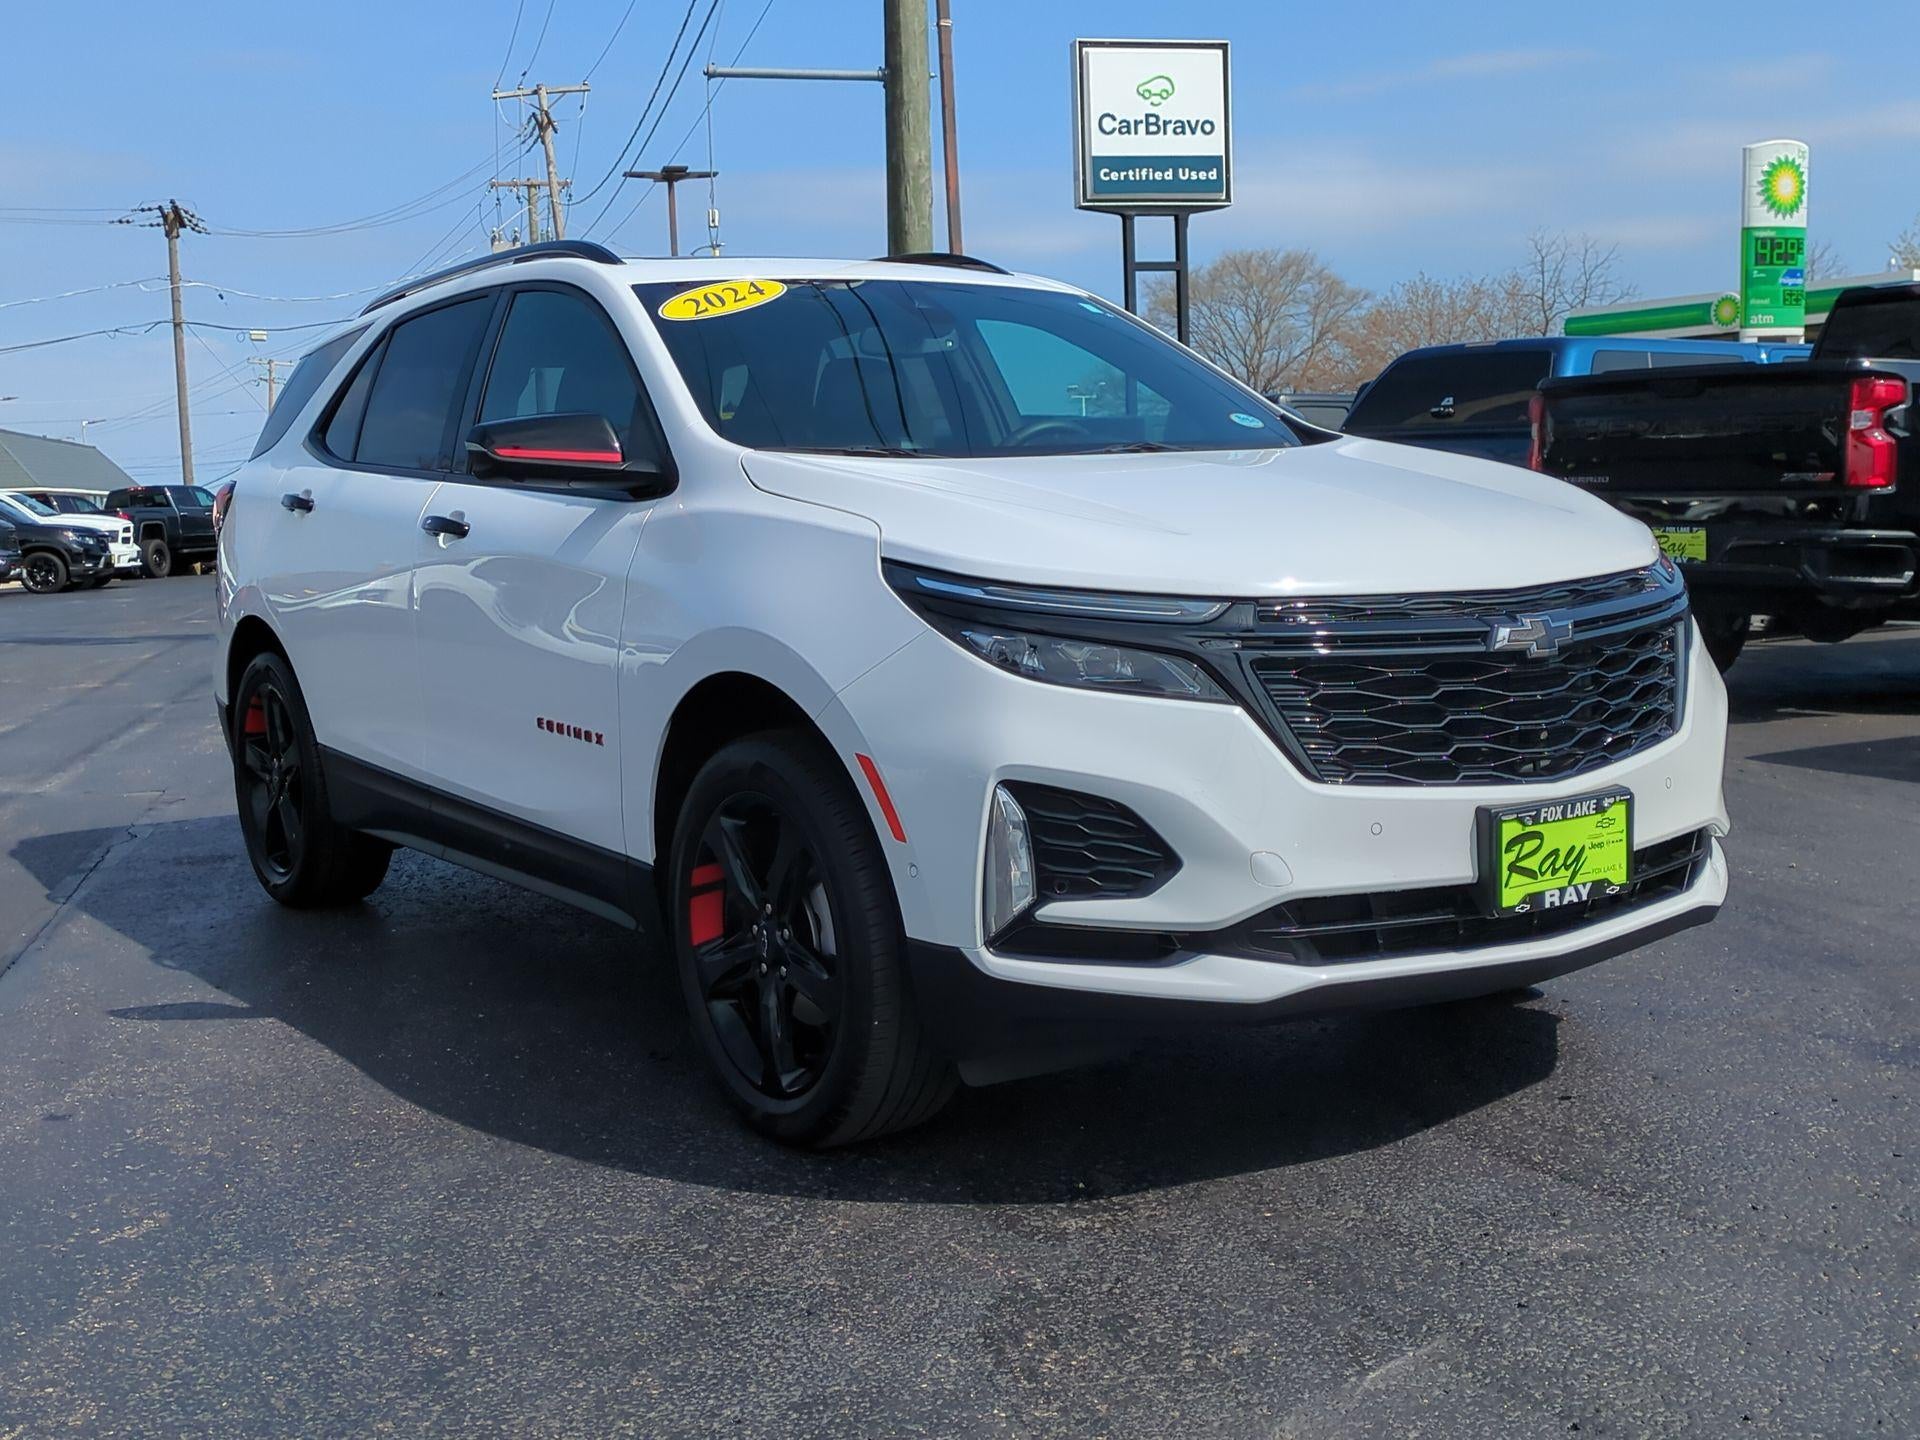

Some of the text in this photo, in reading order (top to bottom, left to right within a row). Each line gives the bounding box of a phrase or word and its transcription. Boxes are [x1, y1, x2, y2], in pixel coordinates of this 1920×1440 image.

[1098, 112, 1216, 136] CarBravo
[1099, 167, 1218, 181] Certified Used
[682, 281, 766, 316] 2024
[1750, 313, 1774, 324] atm
[536, 717, 604, 747] EQUINOX
[1540, 799, 1597, 823] FOX LAKE
[1588, 840, 1605, 850] Jeep
[1504, 830, 1588, 889] Ray
[1544, 882, 1592, 909] RAY
